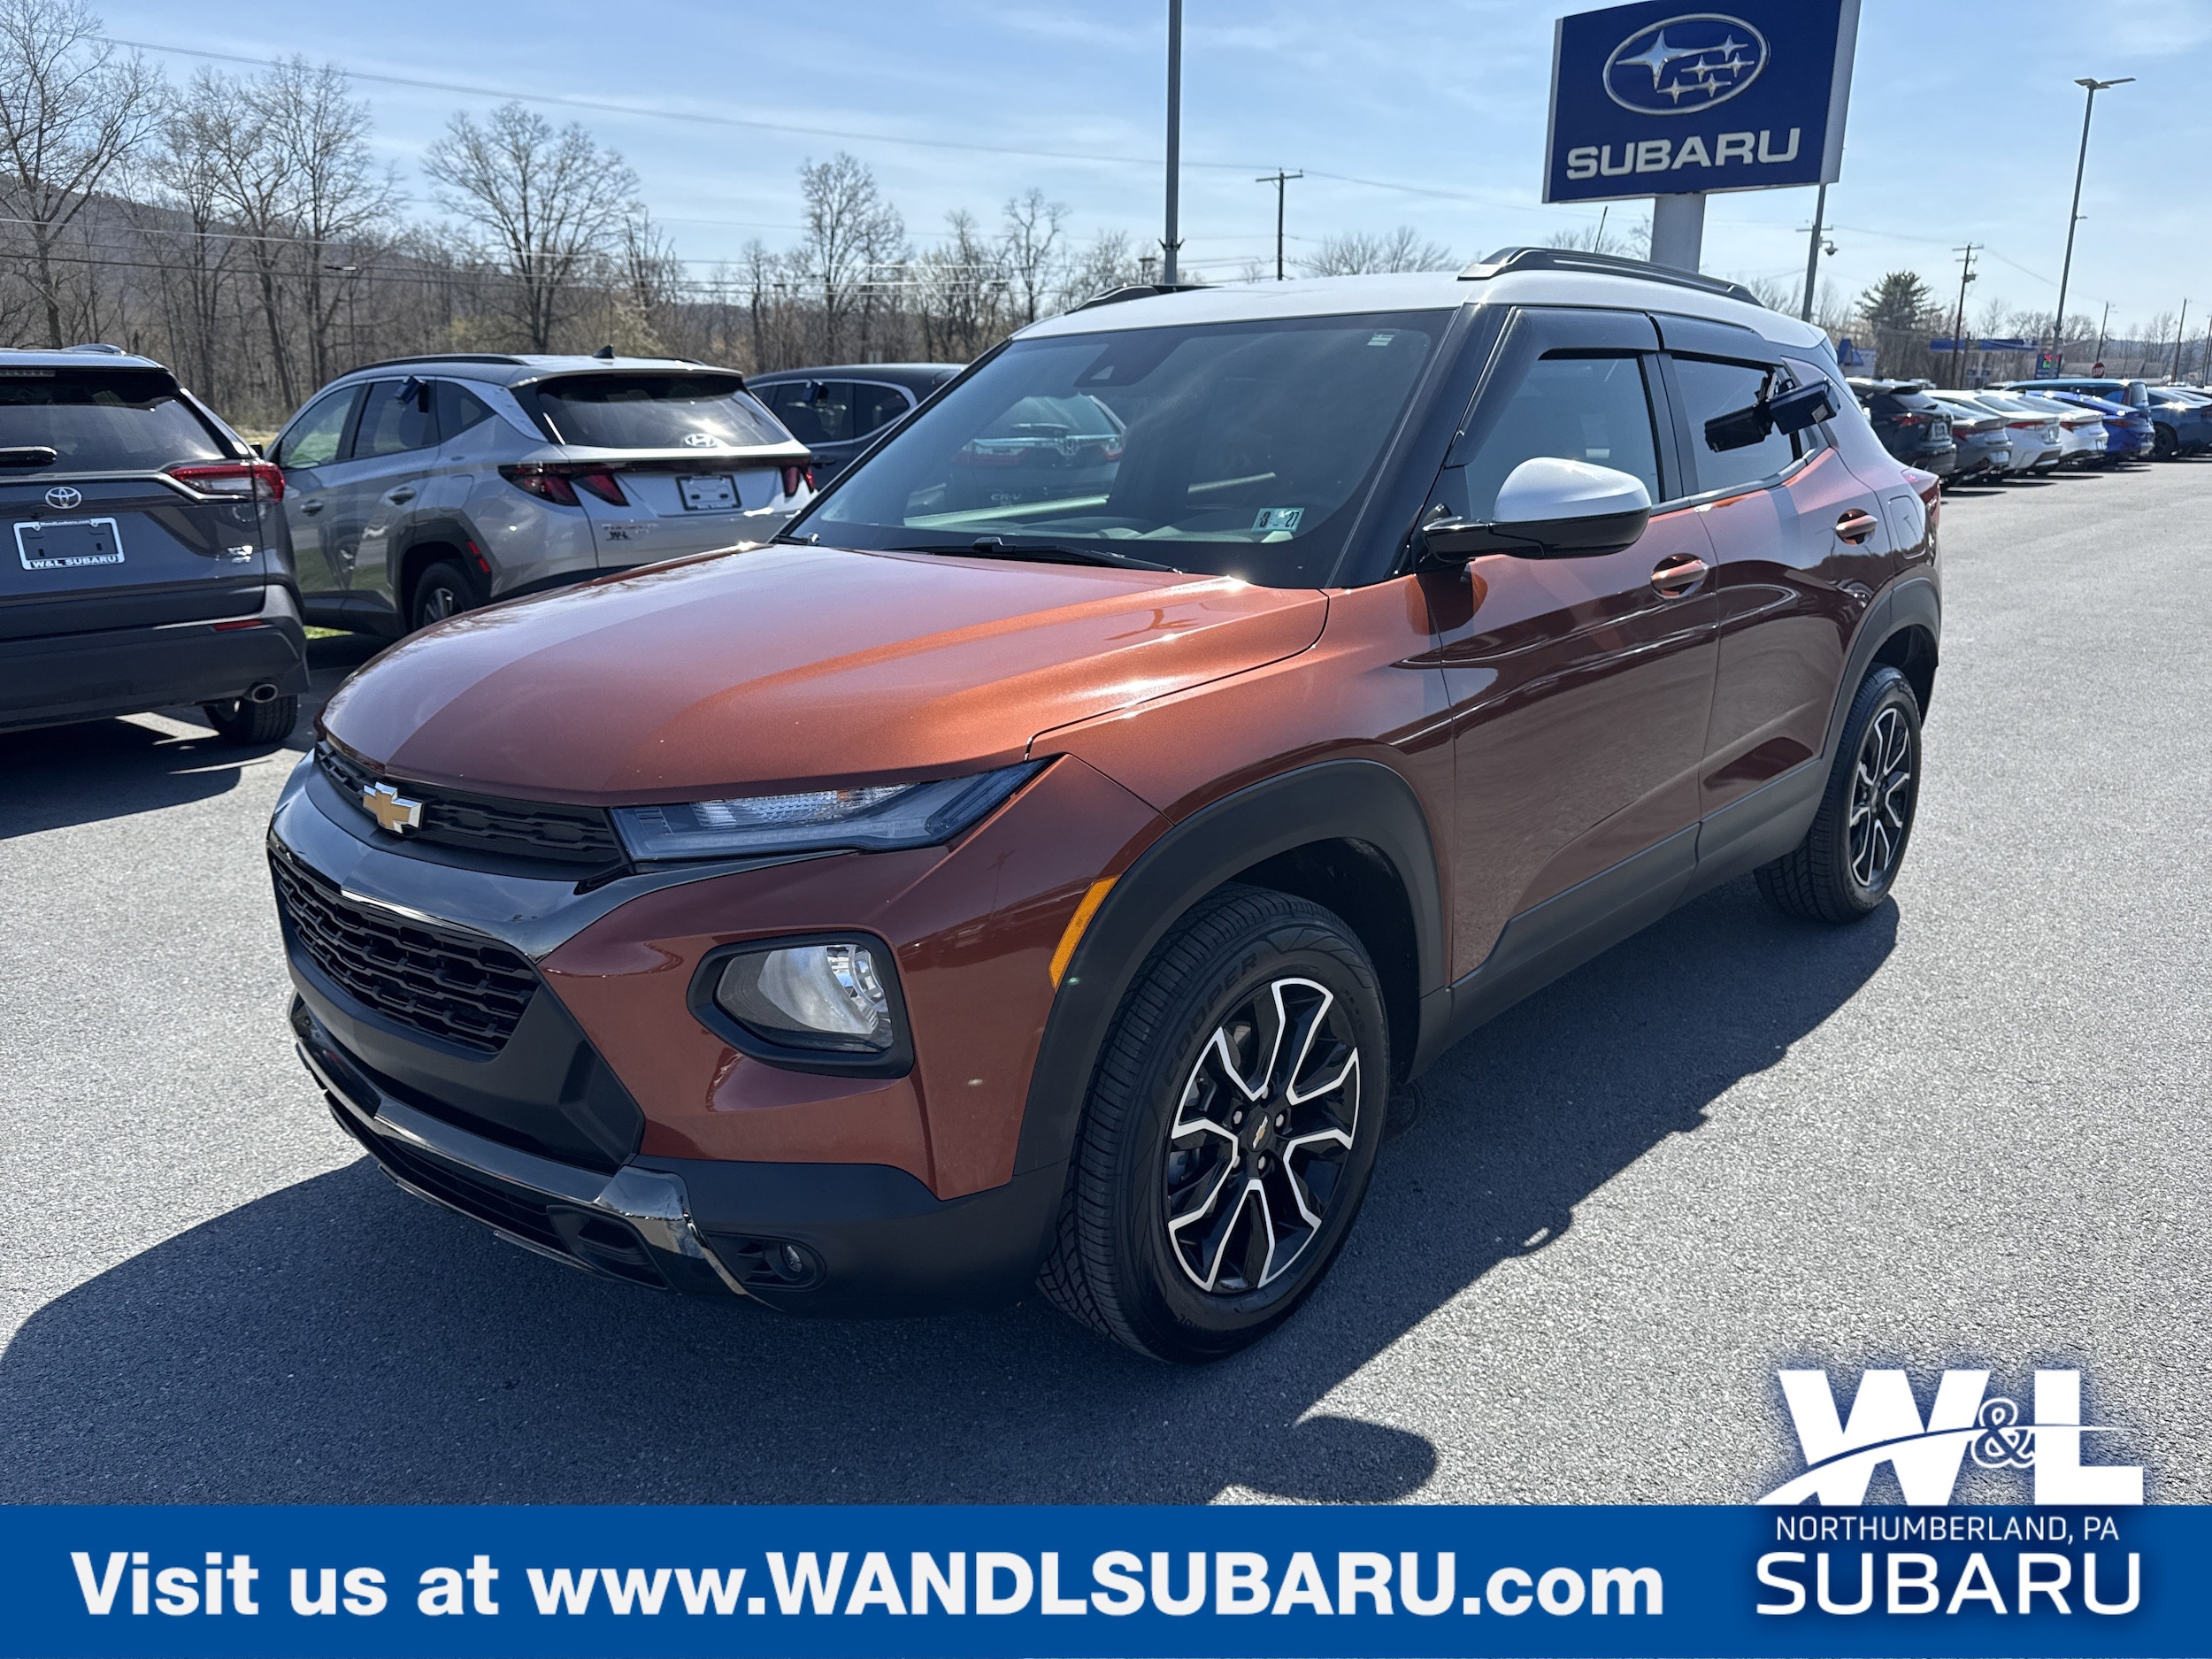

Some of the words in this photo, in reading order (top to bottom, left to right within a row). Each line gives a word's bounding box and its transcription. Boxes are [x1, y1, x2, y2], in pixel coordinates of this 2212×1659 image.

[1565, 127, 1801, 180] SUBARU
[1259, 511, 1271, 527] 3
[1285, 511, 1300, 527] 27
[32, 559, 64, 568] W&L
[65, 555, 118, 566] SUBARU
[1162, 951, 1258, 1087] COOPER
